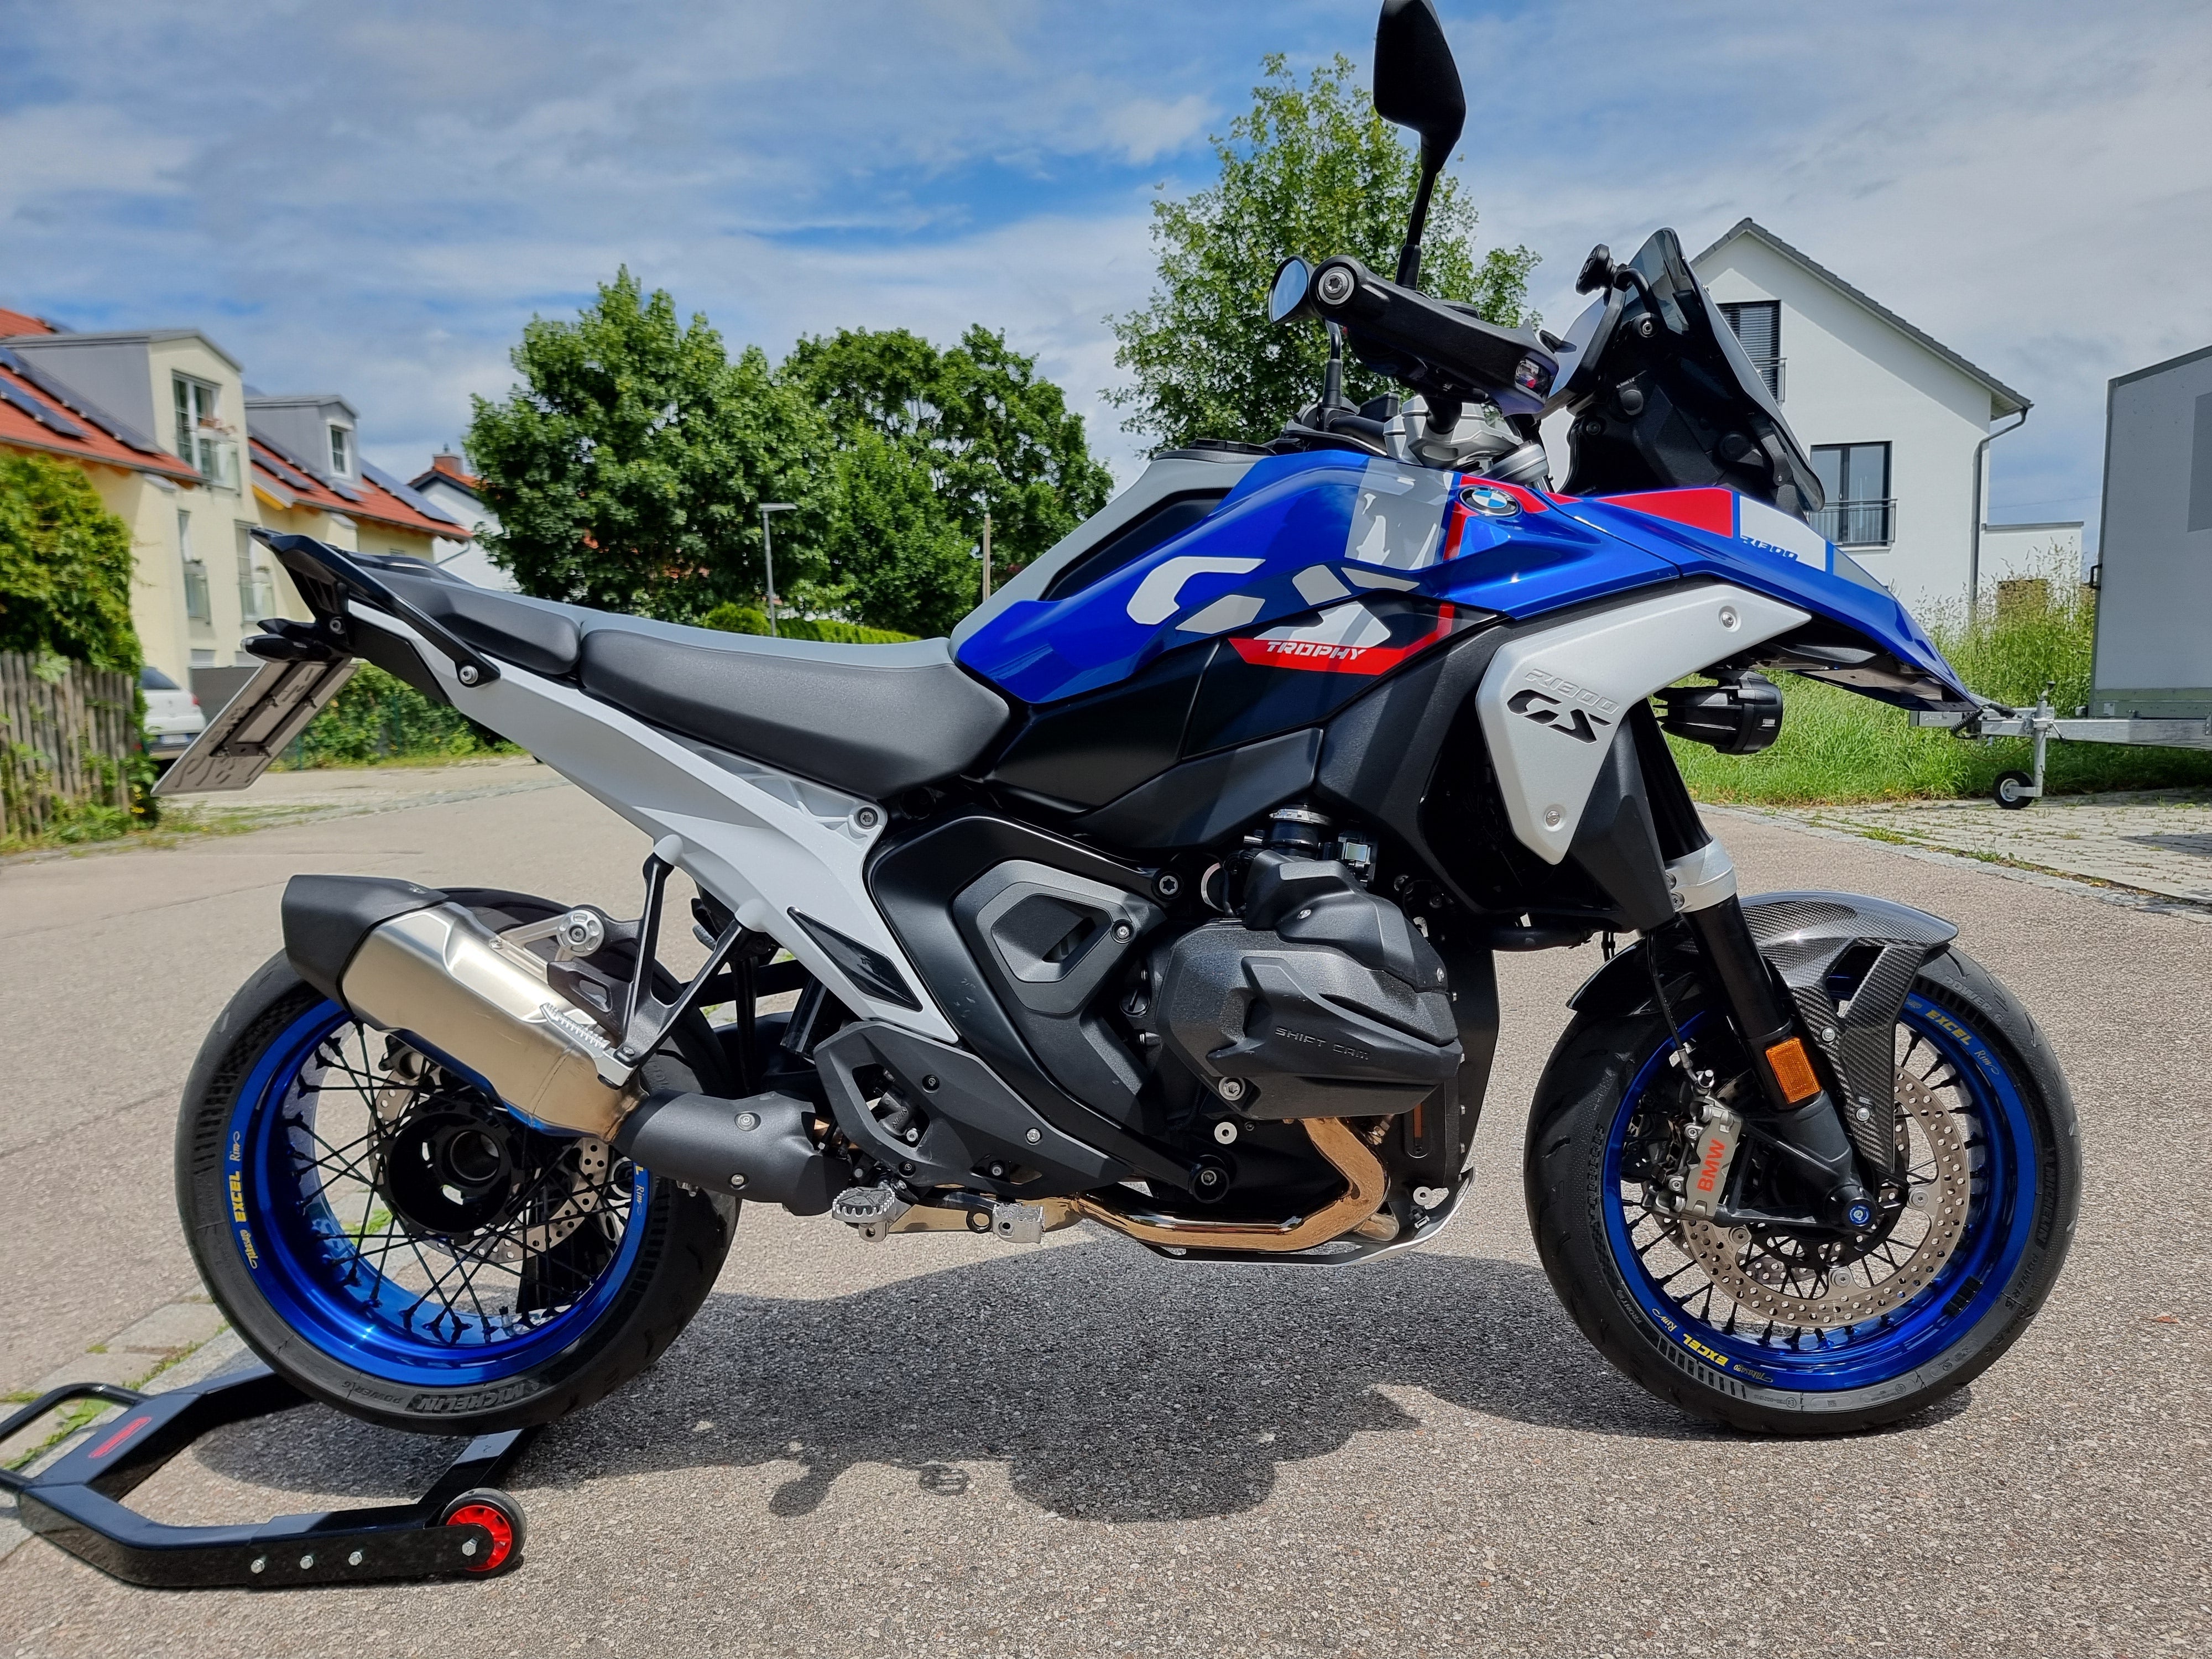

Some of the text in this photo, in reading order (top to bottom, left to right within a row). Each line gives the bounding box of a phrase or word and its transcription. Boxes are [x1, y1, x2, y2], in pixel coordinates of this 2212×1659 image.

[1266, 641, 1366, 660] TROPHY
[1507, 689, 1613, 745] GS
[1942, 974, 1992, 1011] POWER
[1275, 1026, 1326, 1047] SHIFT
[1925, 1009, 1973, 1046] EXCEL
[1697, 1139, 1725, 1192] BMW
[229, 1171, 247, 1223] EXCEL
[2038, 1166, 2056, 1243] MICHELIN
[2011, 1255, 2038, 1302] POWER
[1620, 1300, 1642, 1325] FRONT
[1683, 1333, 1729, 1366] EXCEL
[354, 1384, 404, 1404] POWER
[419, 1384, 525, 1411] MICHELIN
